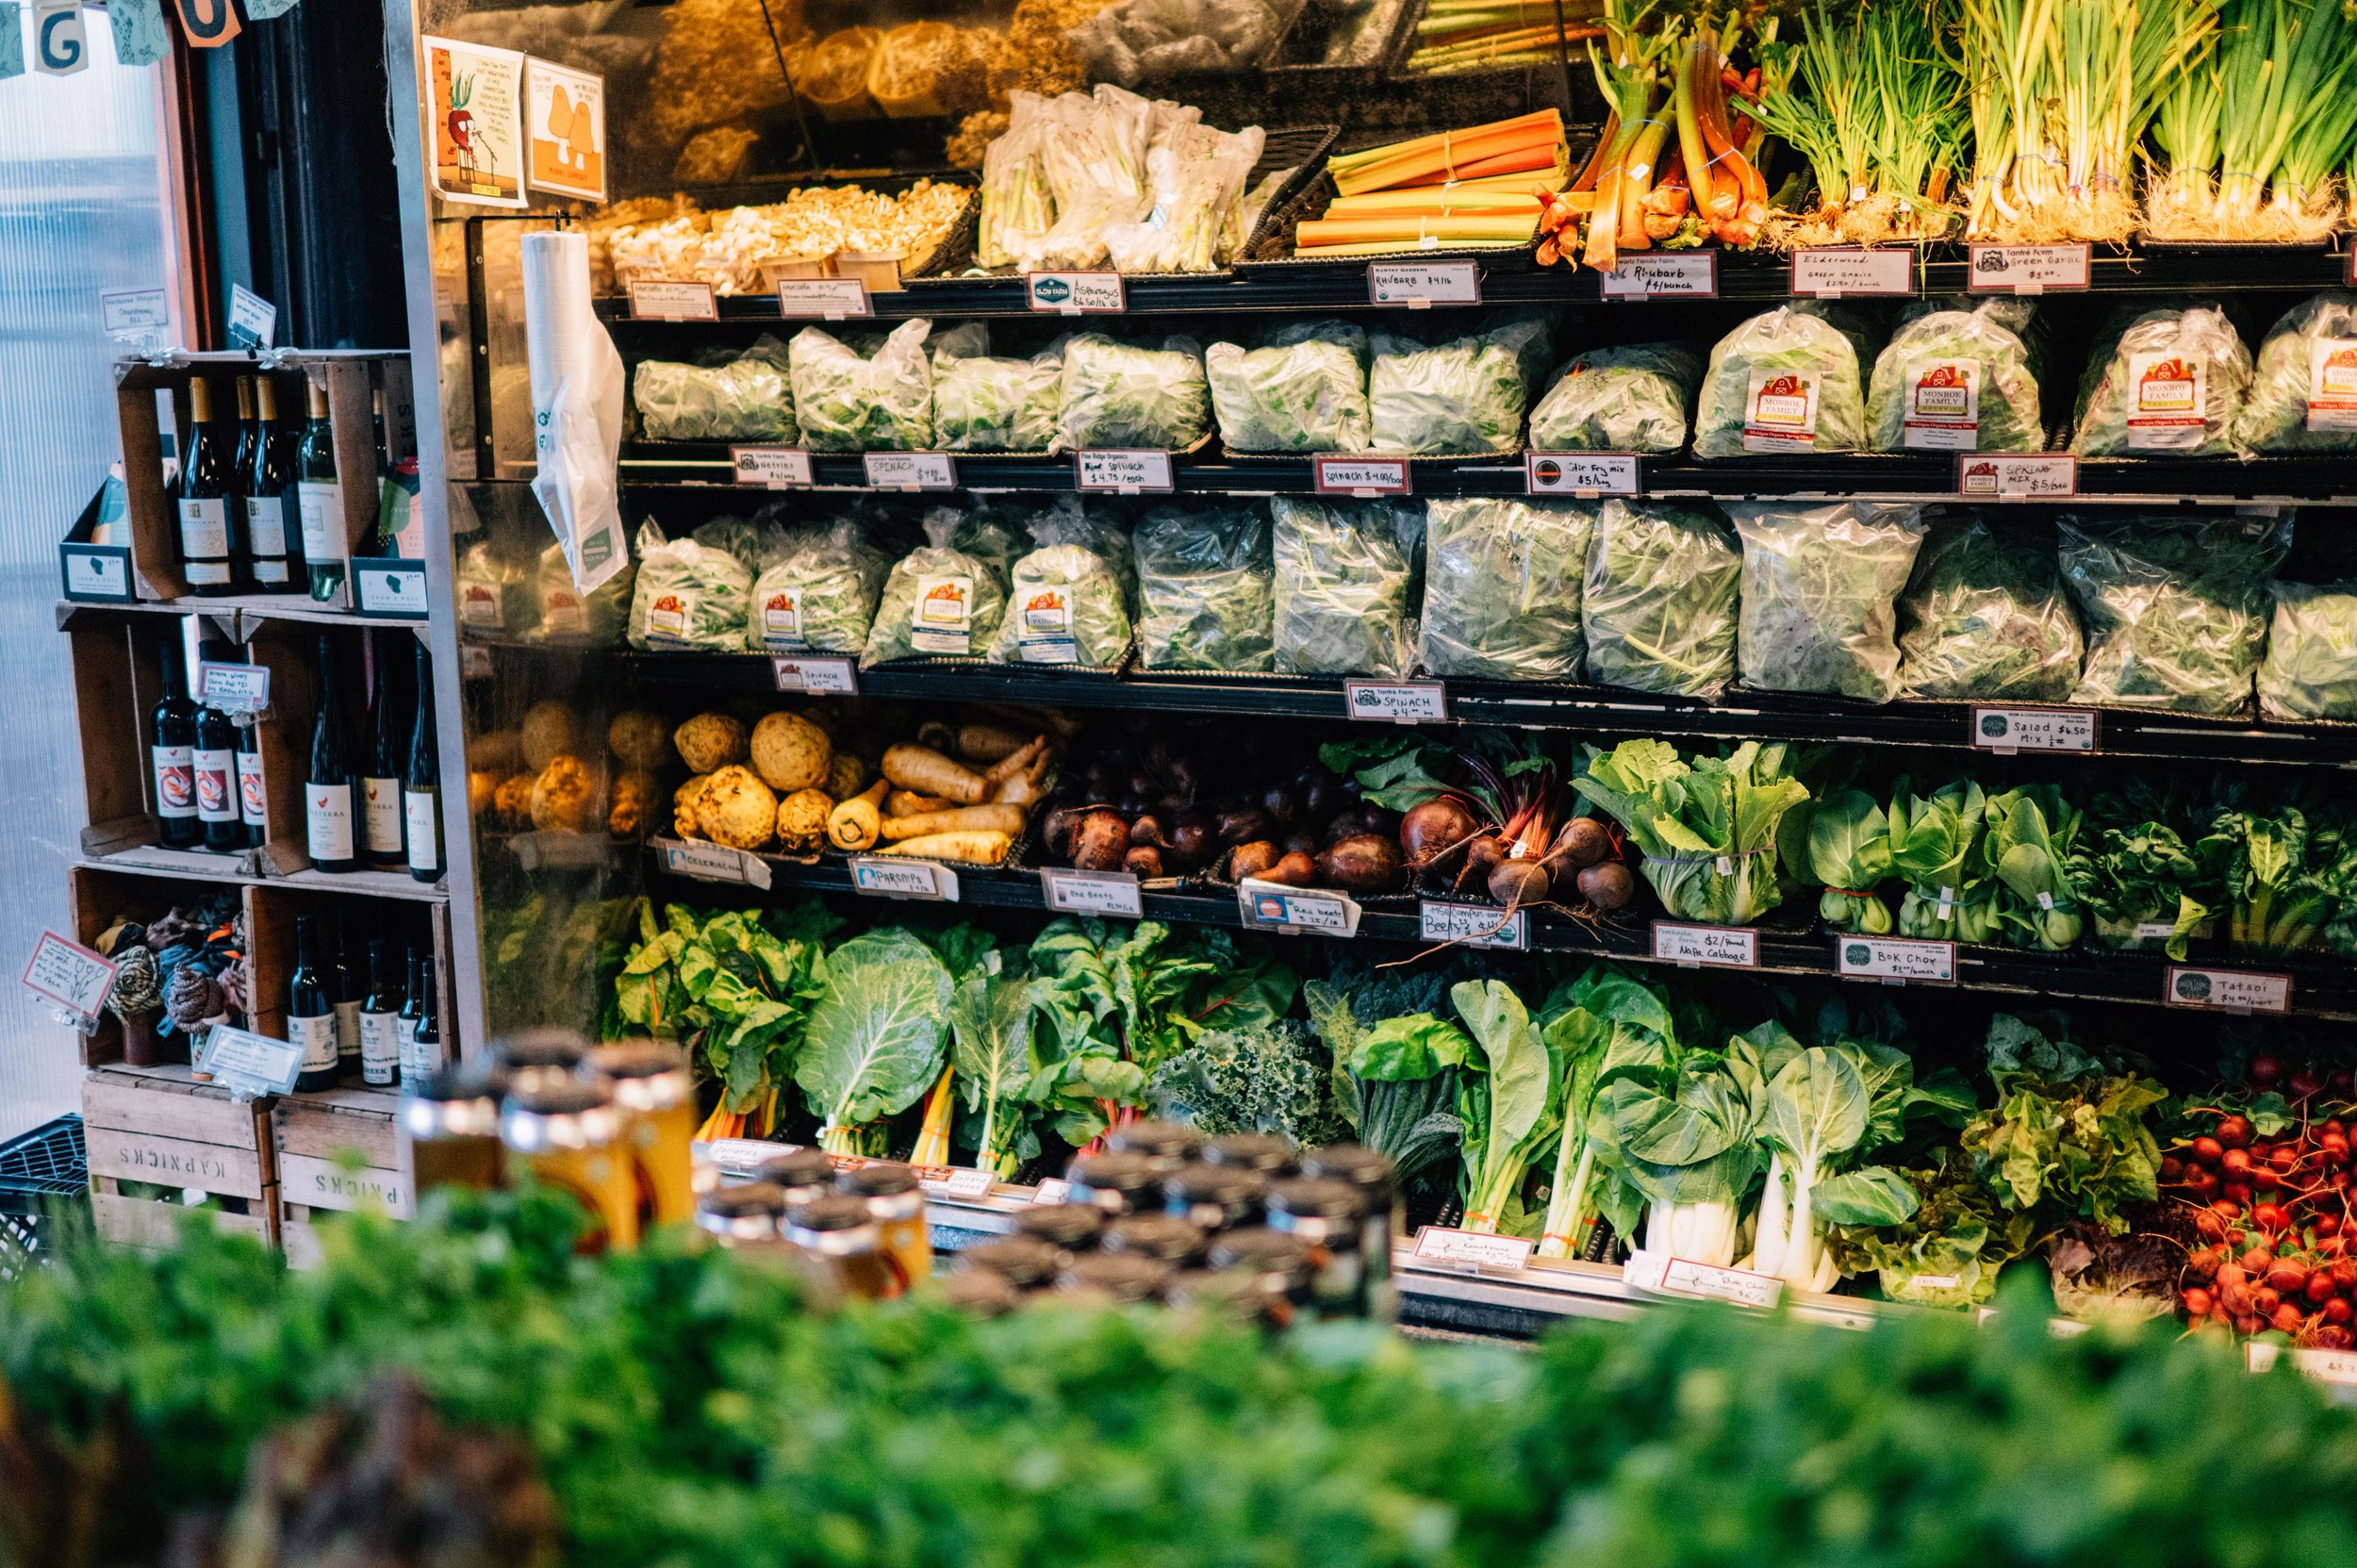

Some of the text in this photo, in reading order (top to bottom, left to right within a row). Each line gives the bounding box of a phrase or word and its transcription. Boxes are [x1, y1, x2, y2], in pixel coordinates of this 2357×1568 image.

[41, 10, 80, 69] G
[2010, 257, 2043, 267] Green
[1634, 266, 1685, 281] Rhubarb
[1376, 274, 1417, 287] RHUBARB
[1074, 278, 1119, 300] Asparagus
[2148, 384, 2187, 392] MONROE
[1765, 398, 1802, 408] MONROE
[1766, 405, 1799, 414] FAMILY
[872, 461, 915, 472] SPINACH
[1568, 462, 1586, 472] Stir
[1591, 464, 1608, 477] Fry
[2007, 475, 2031, 484] MIX
[1383, 696, 1430, 707] SPINACH
[2014, 722, 2051, 732] Salad
[1070, 889, 1113, 900] Red Beets
[1679, 945, 1748, 963] Napa Cabbage
[2217, 981, 2266, 992] Tatsoi
